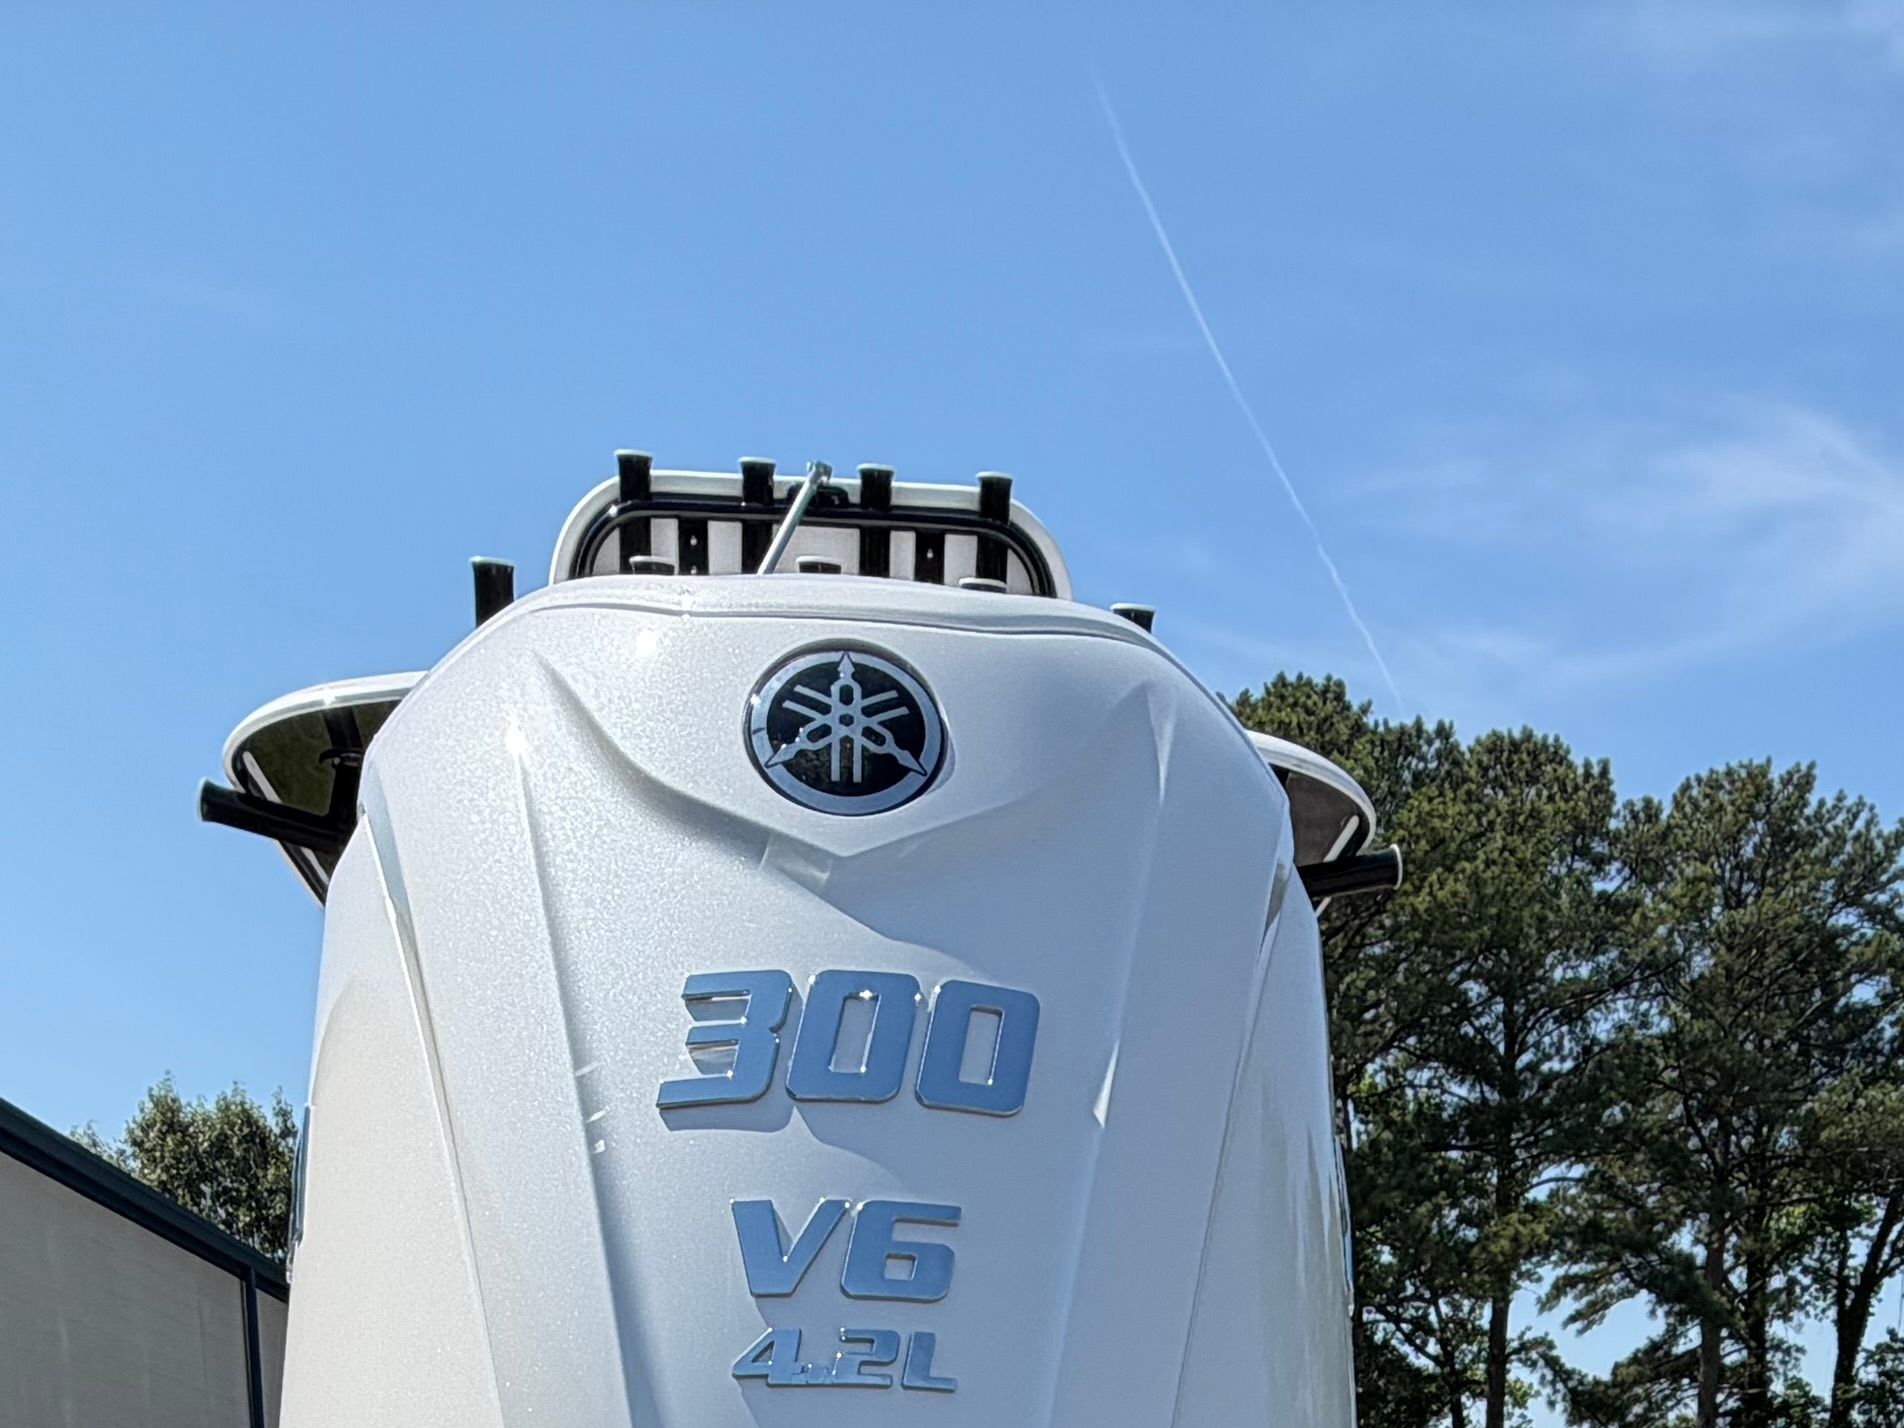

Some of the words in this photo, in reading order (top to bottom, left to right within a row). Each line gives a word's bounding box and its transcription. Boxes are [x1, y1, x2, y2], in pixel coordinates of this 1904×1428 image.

[656, 969, 1041, 1118] 300
[730, 1197, 962, 1303] V6
[732, 1328, 958, 1393] 4.2L
